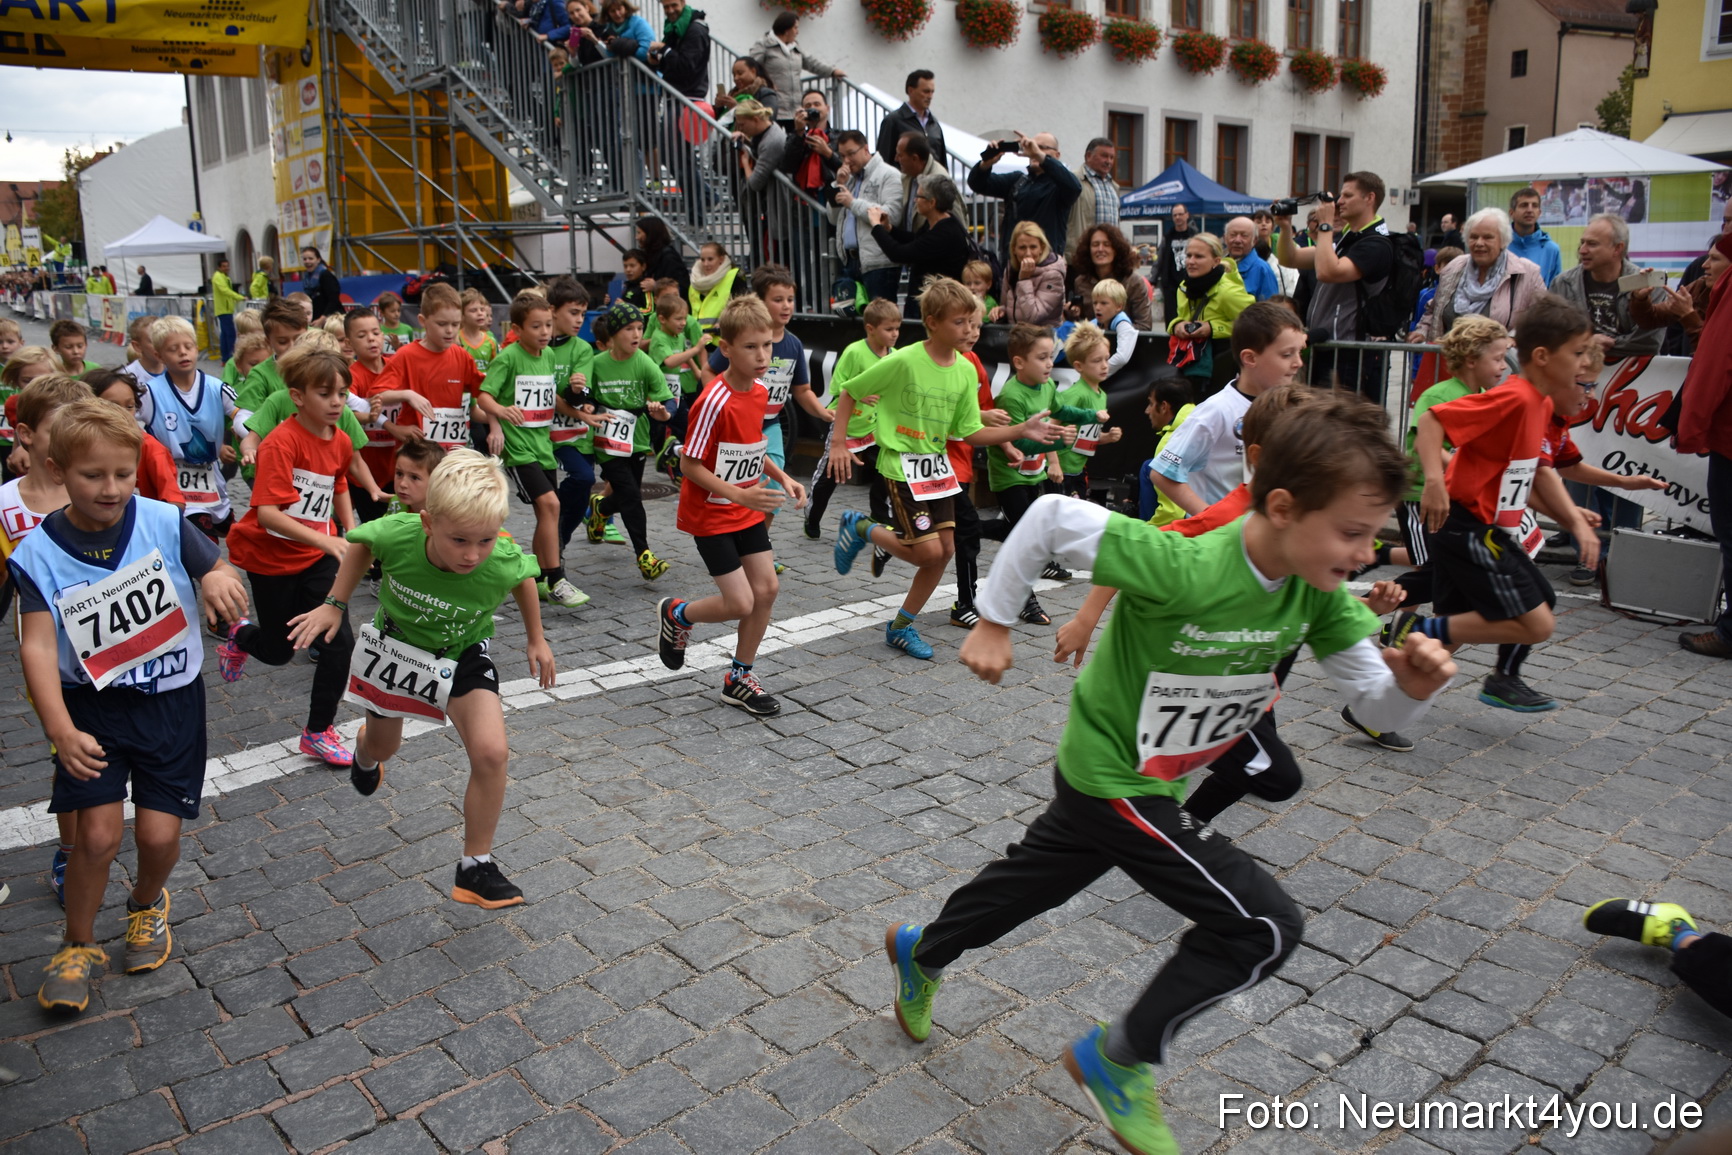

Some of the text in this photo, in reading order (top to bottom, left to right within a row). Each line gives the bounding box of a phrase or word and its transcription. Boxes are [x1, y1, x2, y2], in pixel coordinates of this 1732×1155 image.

[163, 9, 278, 23] Neumarkter Stadtlauf
[131, 45, 236, 56] Neumarkter Stadtlauf
[30, 253, 39, 263] A
[521, 388, 554, 407] 7193
[164, 411, 178, 432] 8
[429, 421, 467, 440] 7132
[896, 424, 926, 440] MERZ
[719, 448, 744, 457] PARTL
[907, 454, 949, 480] 7043
[62, 568, 151, 619] PARTL Neumarkt
[78, 577, 173, 649] 7402
[1178, 623, 1282, 643] Neumarkter
[361, 631, 437, 675] PARTL Neumarkt
[362, 647, 440, 706] 7444
[1150, 686, 1199, 699] PARTL
[1154, 696, 1268, 748] 7125
